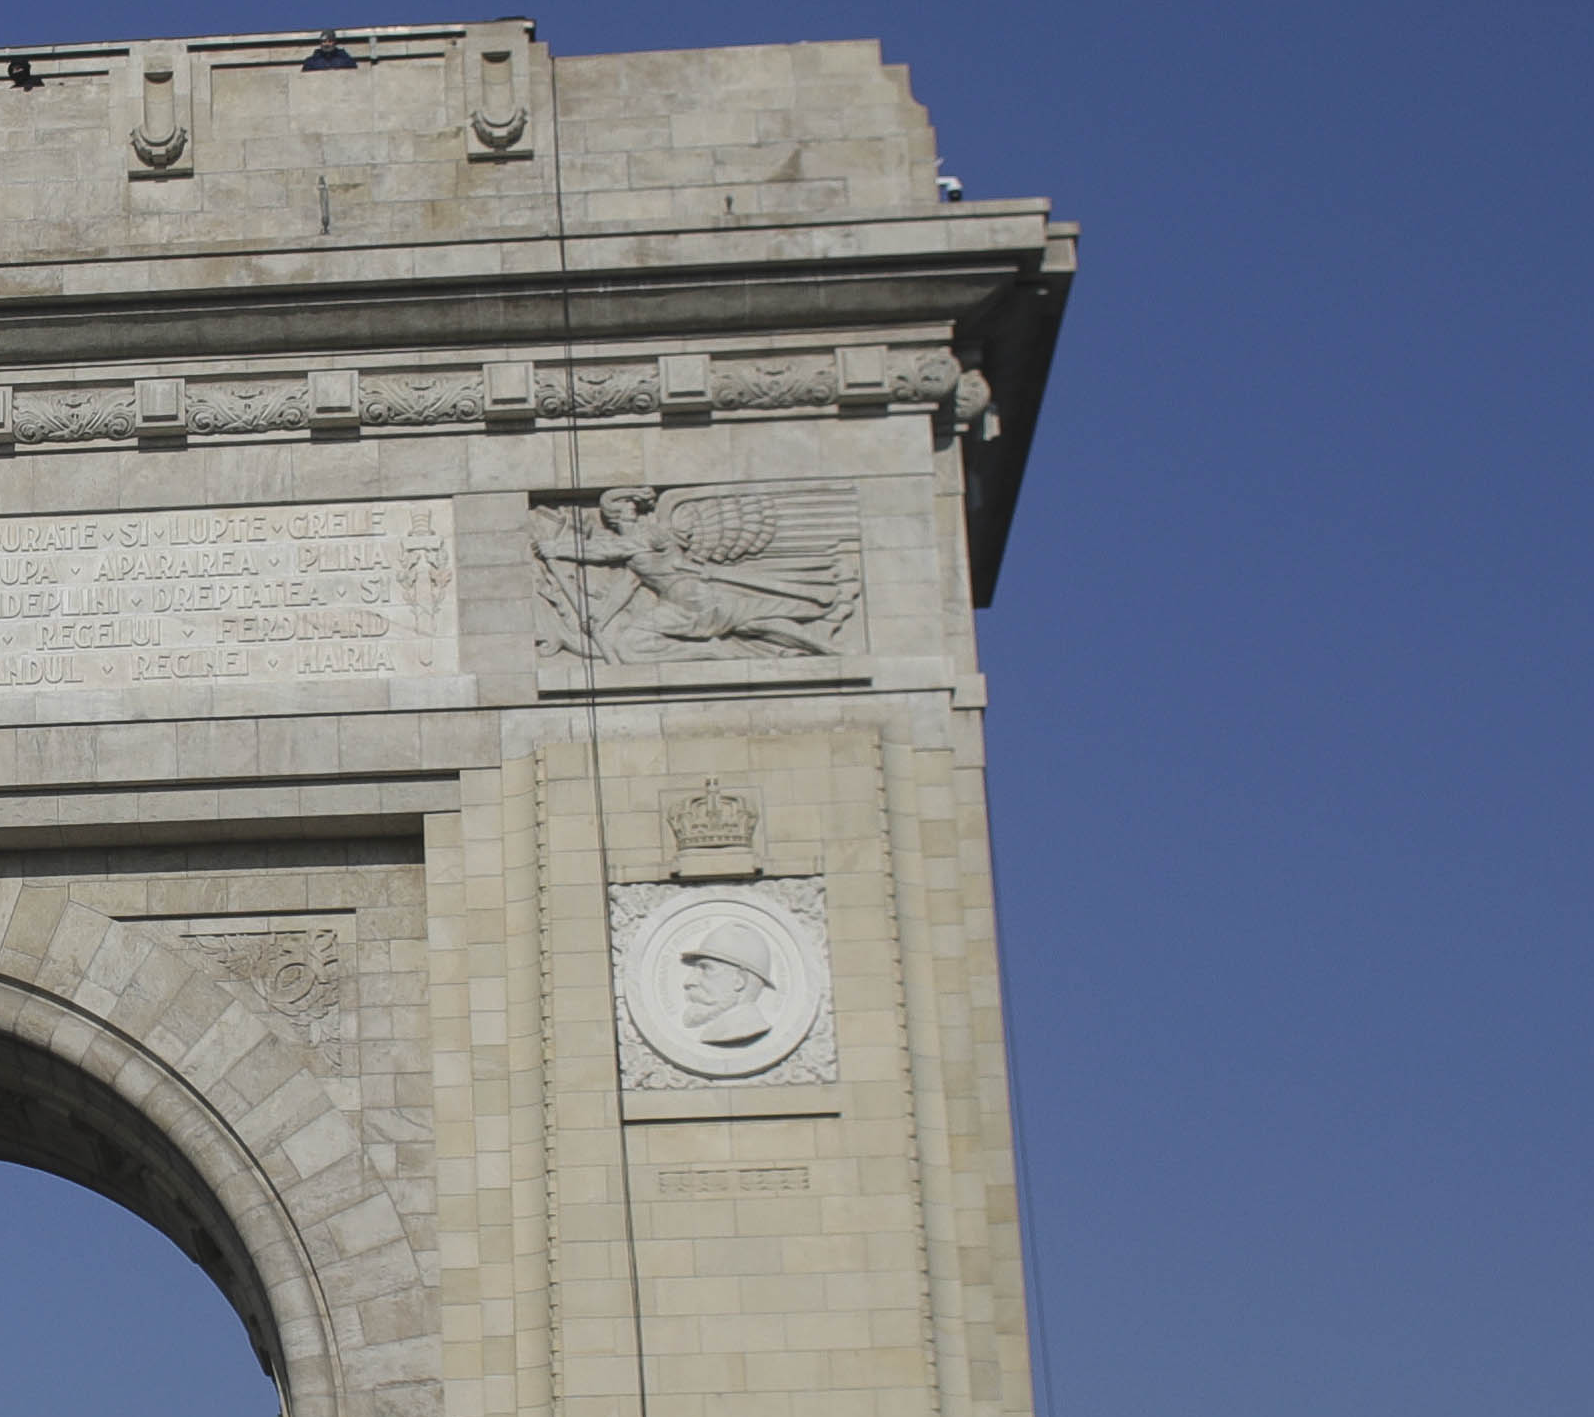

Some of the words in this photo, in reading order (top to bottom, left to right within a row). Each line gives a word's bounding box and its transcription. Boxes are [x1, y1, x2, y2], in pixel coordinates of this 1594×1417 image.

[120, 518, 150, 548] SI
[170, 517, 268, 546] LUPTE
[94, 551, 259, 583] APARAREA
[298, 542, 391, 573] PLINA
[154, 581, 327, 613] DREPTATEA
[359, 576, 391, 604] SI
[216, 611, 390, 644] FERDINAND
